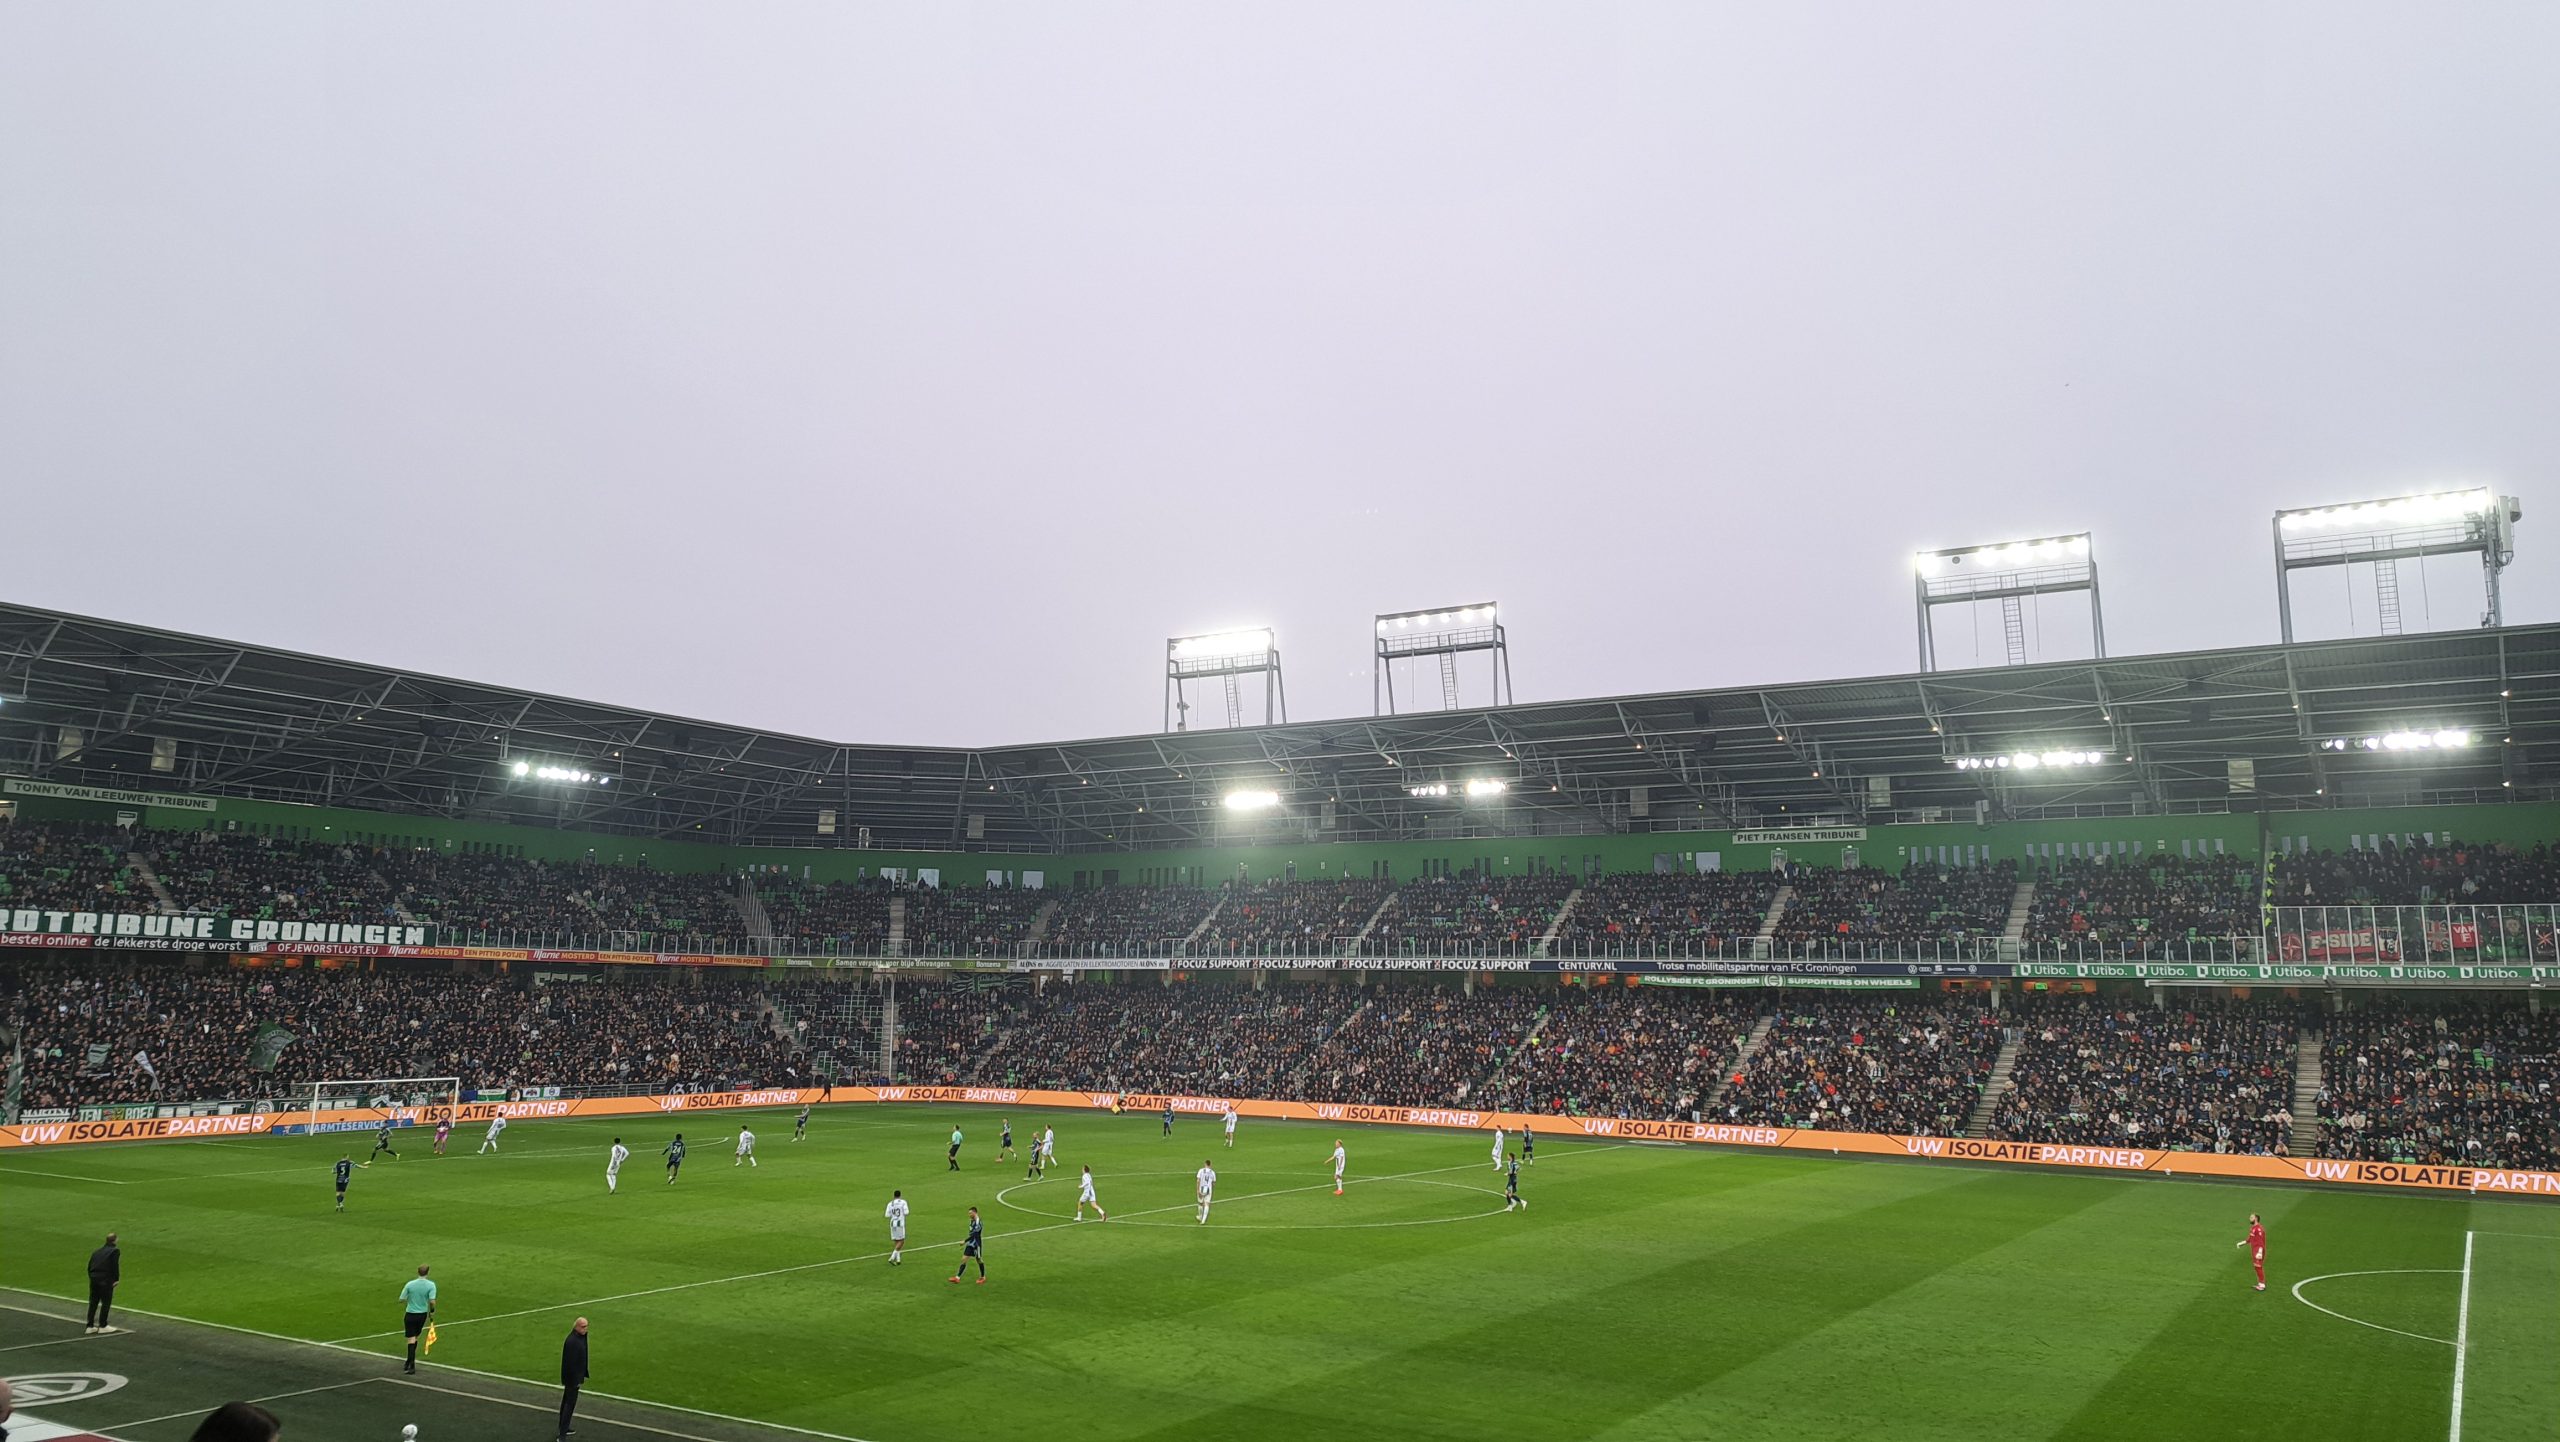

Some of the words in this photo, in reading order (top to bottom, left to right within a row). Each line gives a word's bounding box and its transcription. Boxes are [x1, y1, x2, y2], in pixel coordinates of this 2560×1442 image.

[14, 782, 64, 796] TONNY
[65, 787, 91, 799] VAN
[94, 789, 155, 804] LEEUWEN
[157, 795, 209, 809] TRIBUNE
[1737, 833, 1760, 842] PIET
[1763, 832, 1811, 841] FRANSEN
[1815, 831, 1860, 840] TRIBUNE
[230, 919, 425, 945] GRONINGEN
[1, 933, 43, 946] bestel
[47, 935, 87, 947] online
[95, 936, 109, 947] de
[113, 936, 169, 949] lekkerste
[172, 938, 205, 951] droge
[208, 940, 242, 952] worst
[277, 942, 379, 955] OFJEWORSTLUST.EU
[420, 949, 460, 957] MOSTERD
[561, 953, 595, 961] MOSTERD
[681, 956, 710, 964] MOSTERD
[835, 958, 858, 967] Samen
[1177, 960, 1208, 969] FOCUZ
[1208, 960, 1251, 969] SUPPORT
[1259, 960, 1290, 969] FOCUZ
[1292, 960, 1336, 969] SUPPORT
[1349, 960, 1383, 969] FOCUZ
[1385, 960, 1432, 970] SUPPORT
[1442, 960, 1478, 970] FOCUZ
[1480, 961, 1531, 970] SUPPORT
[1558, 961, 1618, 970] CENTURY.NL
[1657, 962, 1685, 971] Trotse
[1686, 962, 1769, 973] mobiliteitspartner
[1771, 964, 1788, 972] van
[1791, 964, 1803, 972] FC
[1805, 964, 1857, 975] Groningen
[2034, 965, 2069, 976] Utibo.
[2091, 965, 2128, 976] Utibo.
[2150, 966, 2188, 977] Utibo.
[2212, 966, 2250, 977] Utibo.
[2275, 967, 2315, 977] Utibo.
[2341, 967, 2382, 978] Utibo.
[2407, 967, 2450, 979] Utibo.
[2478, 967, 2522, 978] Utibo.
[1644, 975, 1692, 984] ROLLYSIDE
[1692, 977, 1704, 985] FC
[1706, 977, 1760, 985] GRONINGEN
[1788, 978, 1853, 986] SUPPORTERS
[878, 1087, 906, 1099] UW
[908, 1087, 1017, 1102] ISOLATIEPARTNER
[1092, 1093, 1115, 1106] UW
[660, 1096, 685, 1110] UW
[687, 1091, 798, 1108] ISOLATIEPARTNER
[79, 1108, 102, 1122] TEN
[1318, 1104, 1344, 1119] UW
[1346, 1106, 1479, 1126] ISOLATIEPARTNER
[20, 1124, 65, 1143] UW
[69, 1115, 264, 1141] ISOLATIEPARTNER
[1584, 1119, 1614, 1134] UW
[1618, 1122, 1778, 1145] ISOLATIEPARTNER
[1907, 1138, 1943, 1155] UW
[1948, 1141, 2145, 1168] ISOLATIEPARTNER
[2304, 1160, 2351, 1180] UW
